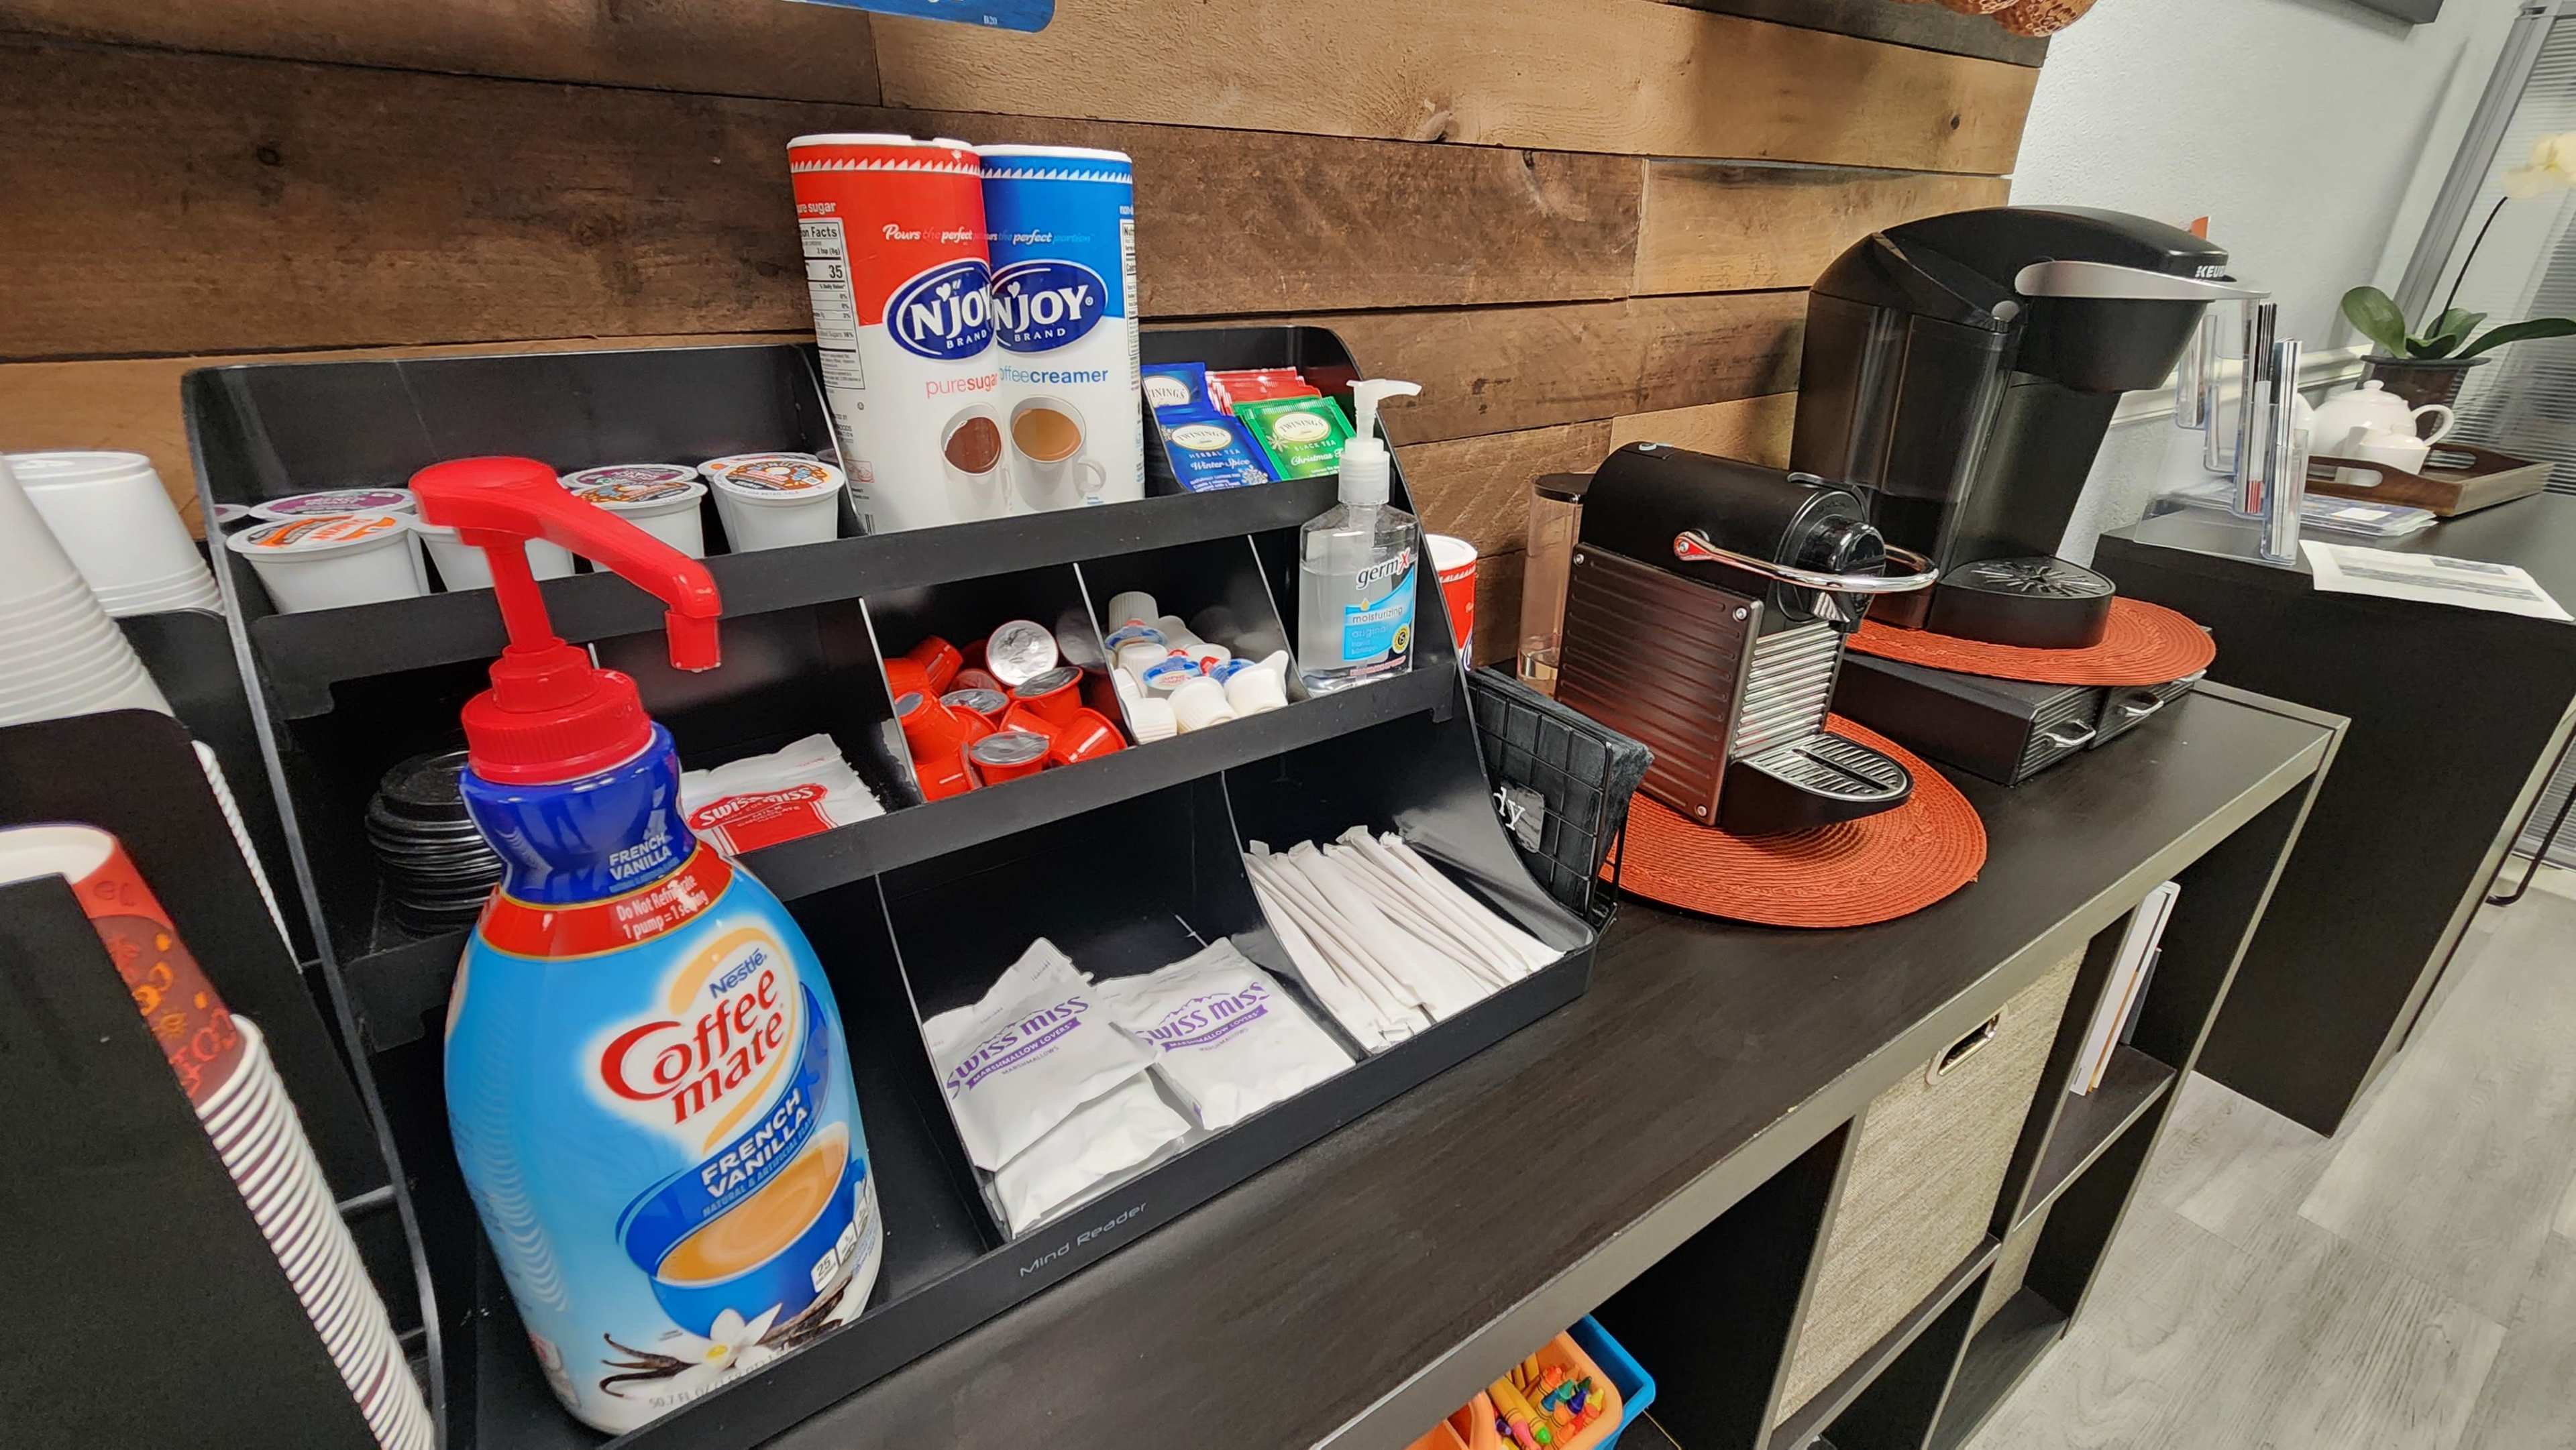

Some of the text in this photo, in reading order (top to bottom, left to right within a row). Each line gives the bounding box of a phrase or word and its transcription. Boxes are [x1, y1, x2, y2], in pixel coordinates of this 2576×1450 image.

[808, 203, 837, 215] sugar
[811, 227, 838, 237] Facts
[882, 223, 922, 240] Pours
[941, 227, 973, 244] perfect
[1013, 229, 1053, 245] perfect
[828, 264, 843, 279] 35
[946, 329, 987, 349] BRAND
[1014, 327, 1066, 342] BRAND
[1190, 461, 1224, 470] Winter
[1291, 454, 1334, 465] Christmas
[1352, 607, 1403, 624] moisturizing
[609, 832, 666, 867] FRENCH
[610, 846, 672, 881] VANILLA
[616, 905, 633, 922] Do
[632, 897, 654, 915] Not
[623, 923, 631, 939] 1
[633, 914, 664, 940] pump
[669, 905, 680, 920] 1
[600, 969, 778, 1102] Coffee
[1169, 1026, 1229, 1048] MARSHMALLOW
[973, 1024, 1071, 1083] MARSHMALLOW LOVERS
[1001, 1046, 1060, 1075] MARSHMALLOWS
[672, 1011, 784, 1125] mate
[702, 1087, 801, 1186] FRENCH
[707, 1107, 808, 1198] VANILLA
[702, 1184, 747, 1217] NATURAL
[1020, 1202, 1146, 1278] Mind Reader
[816, 1256, 831, 1278] 25
